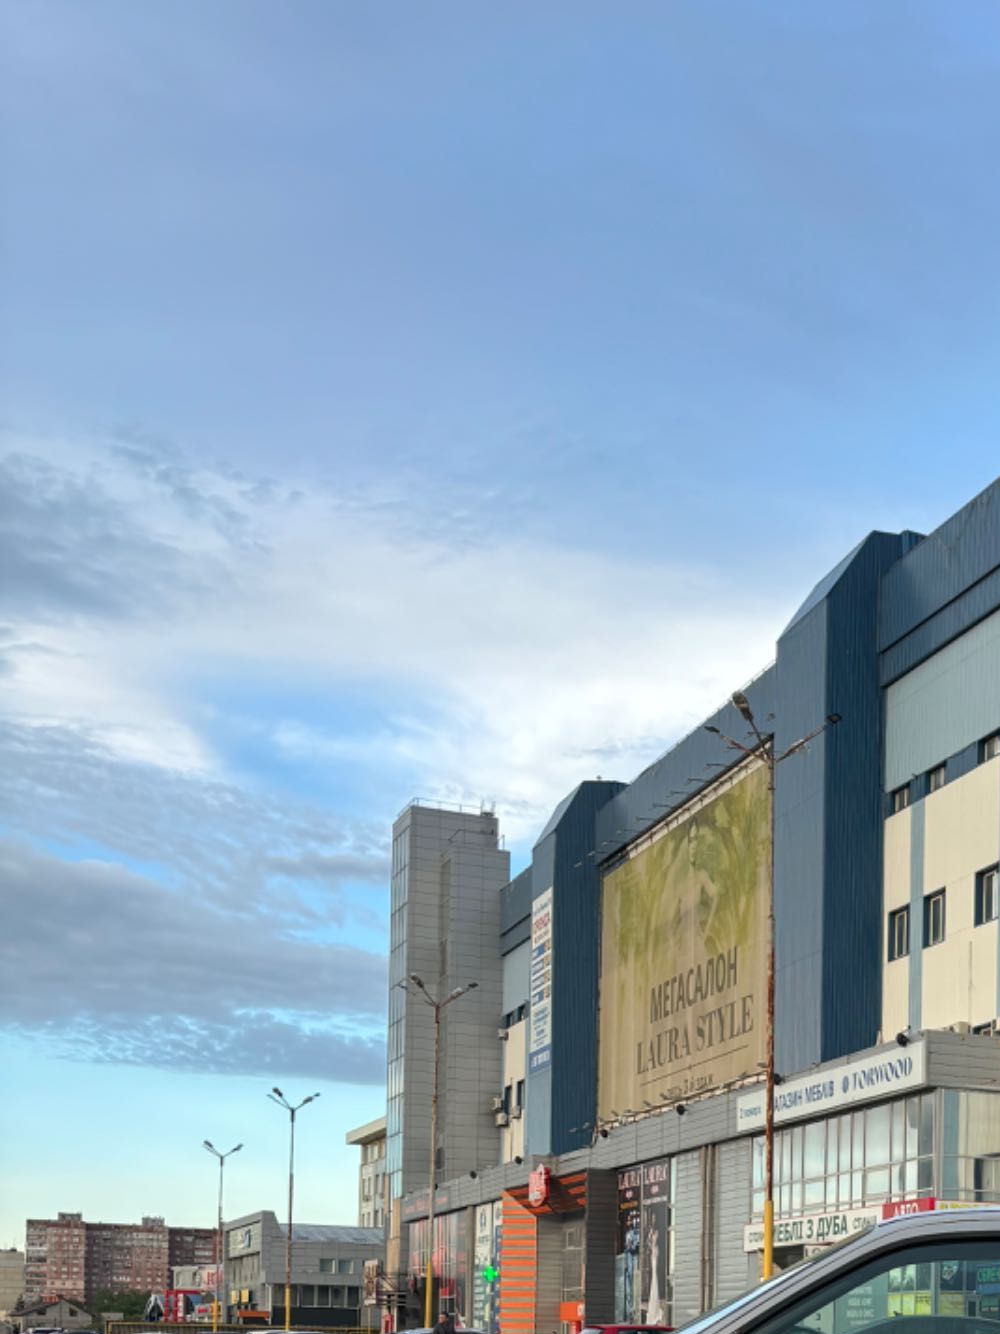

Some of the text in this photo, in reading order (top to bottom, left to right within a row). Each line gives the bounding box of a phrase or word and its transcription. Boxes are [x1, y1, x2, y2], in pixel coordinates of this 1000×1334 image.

[650, 945, 738, 1025] МЕГАСАЛОН
[637, 994, 754, 1075] LAURA STYLE
[852, 1056, 914, 1091] TORWOOD
[774, 1080, 835, 1113] АГАЗИН МЕБЛІВ
[816, 1215, 848, 1241] ДУБА
